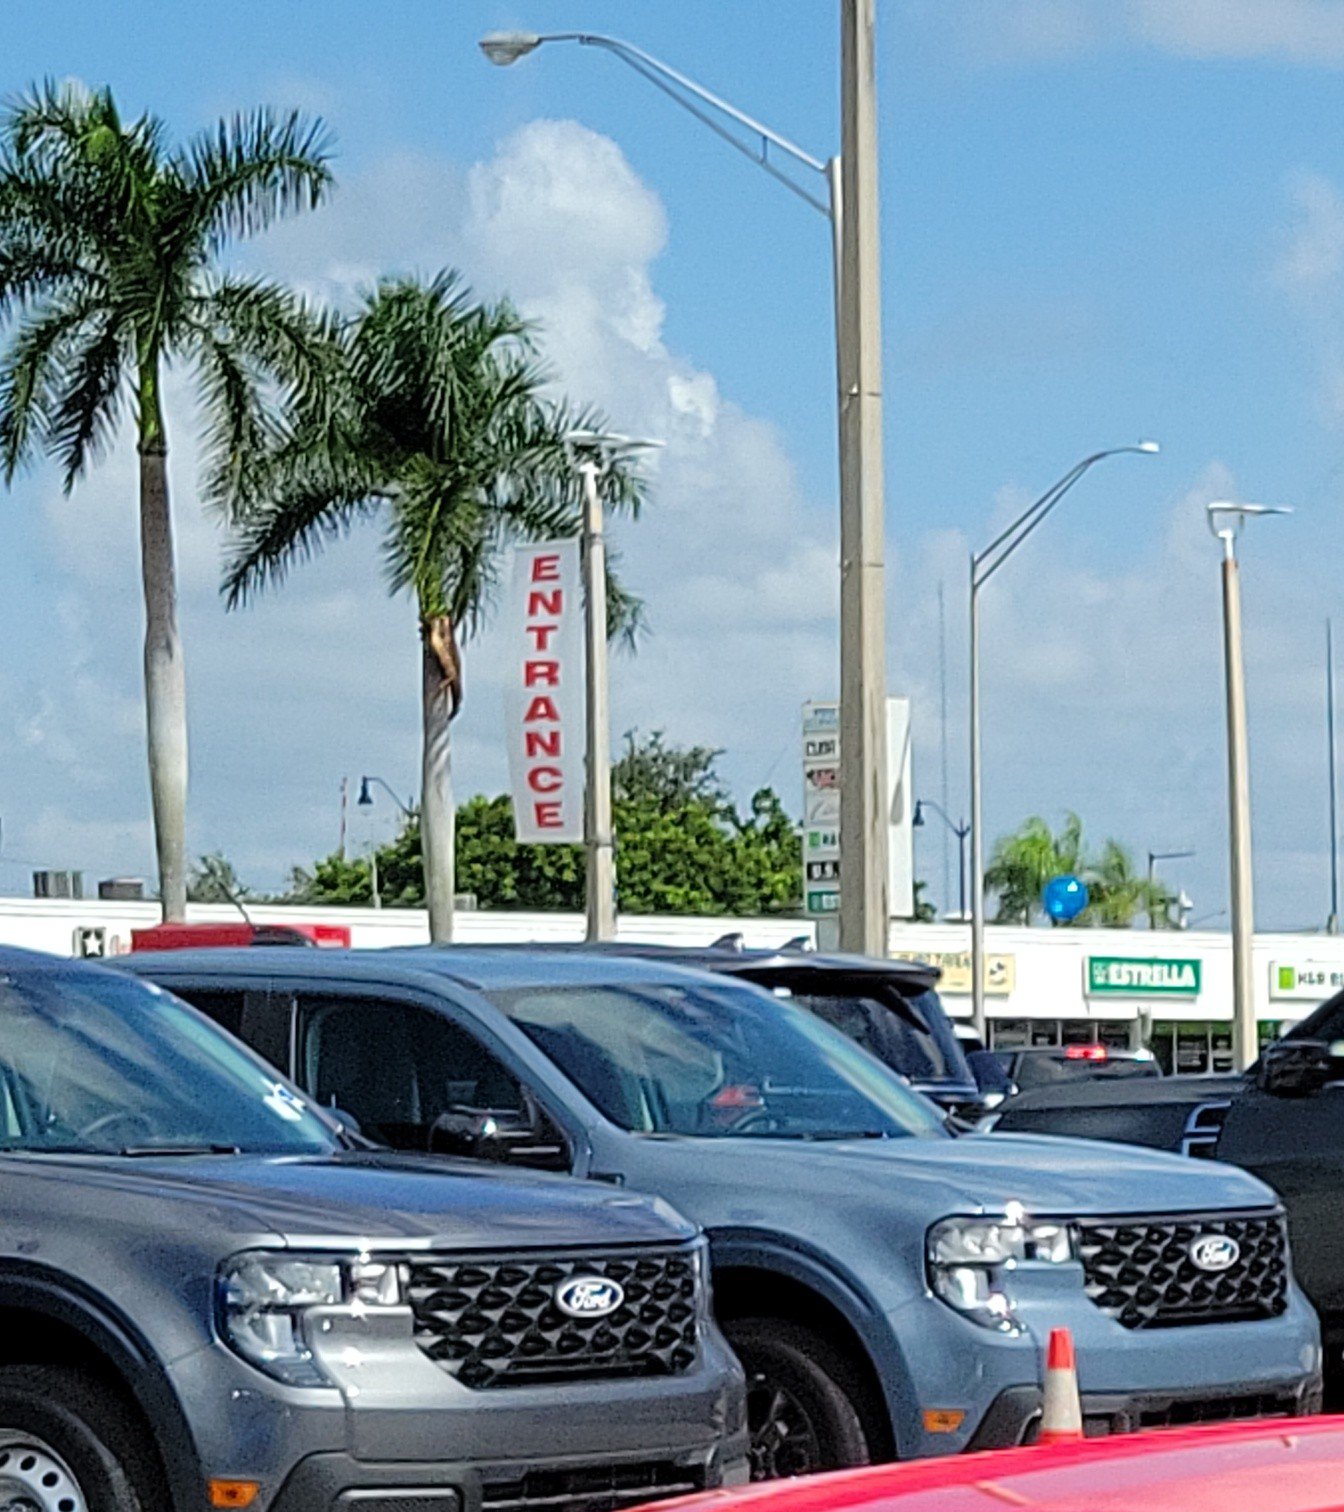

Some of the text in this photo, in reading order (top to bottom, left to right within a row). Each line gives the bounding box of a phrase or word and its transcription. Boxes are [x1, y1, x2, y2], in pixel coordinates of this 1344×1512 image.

[522, 554, 565, 830] ENTRANCE
[1108, 962, 1196, 987] ESTRELLA
[569, 1284, 613, 1311] Ford
